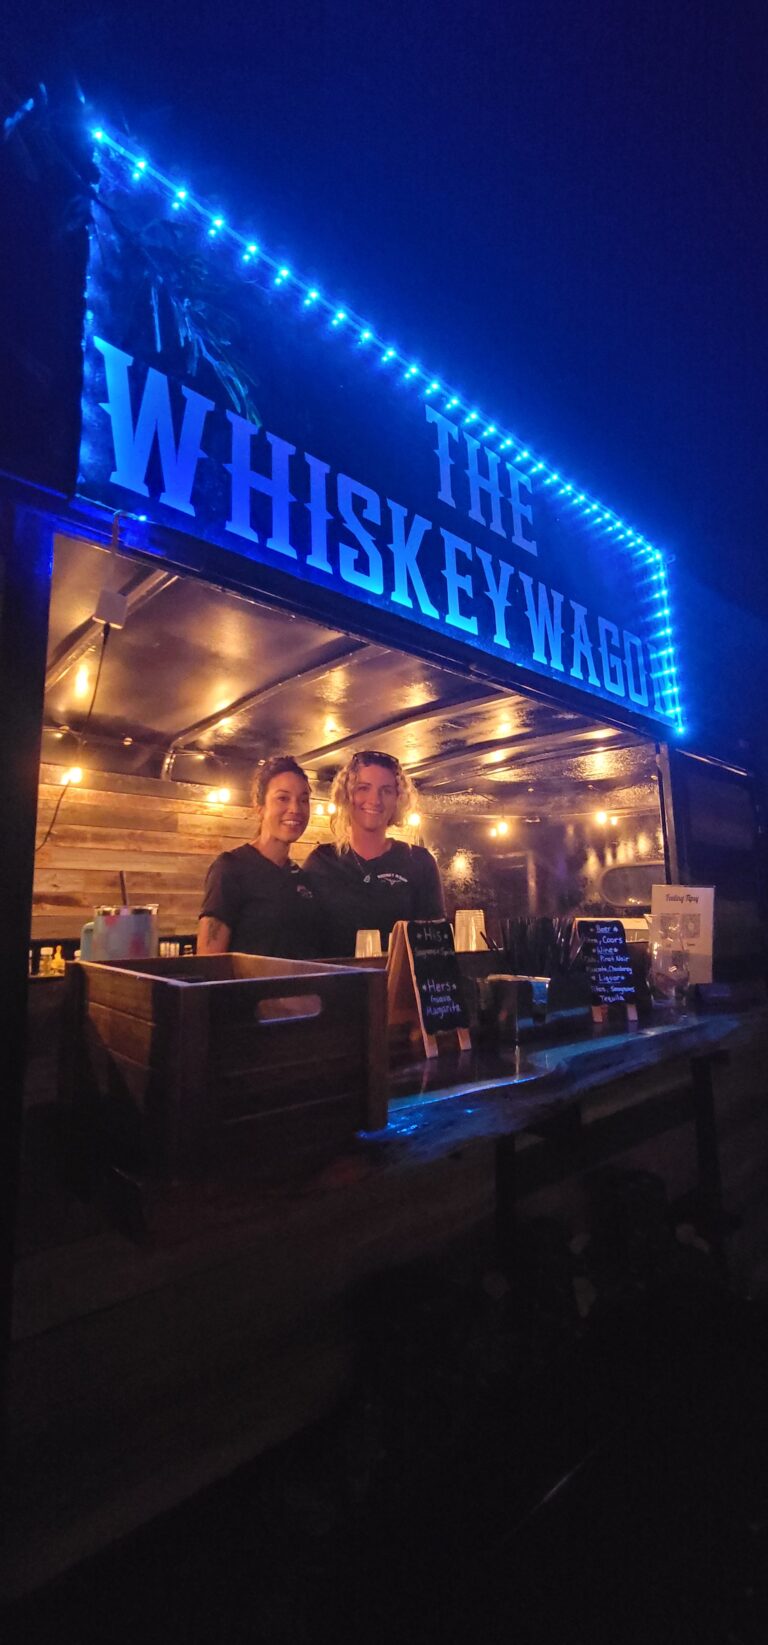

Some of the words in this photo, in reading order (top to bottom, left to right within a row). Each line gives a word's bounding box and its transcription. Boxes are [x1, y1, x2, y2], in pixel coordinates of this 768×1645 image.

[426, 405, 538, 557] THE
[94, 335, 514, 648] WHISKEY
[424, 928, 441, 941] His
[596, 924, 610, 933] Beer
[428, 979, 451, 992] Hers
